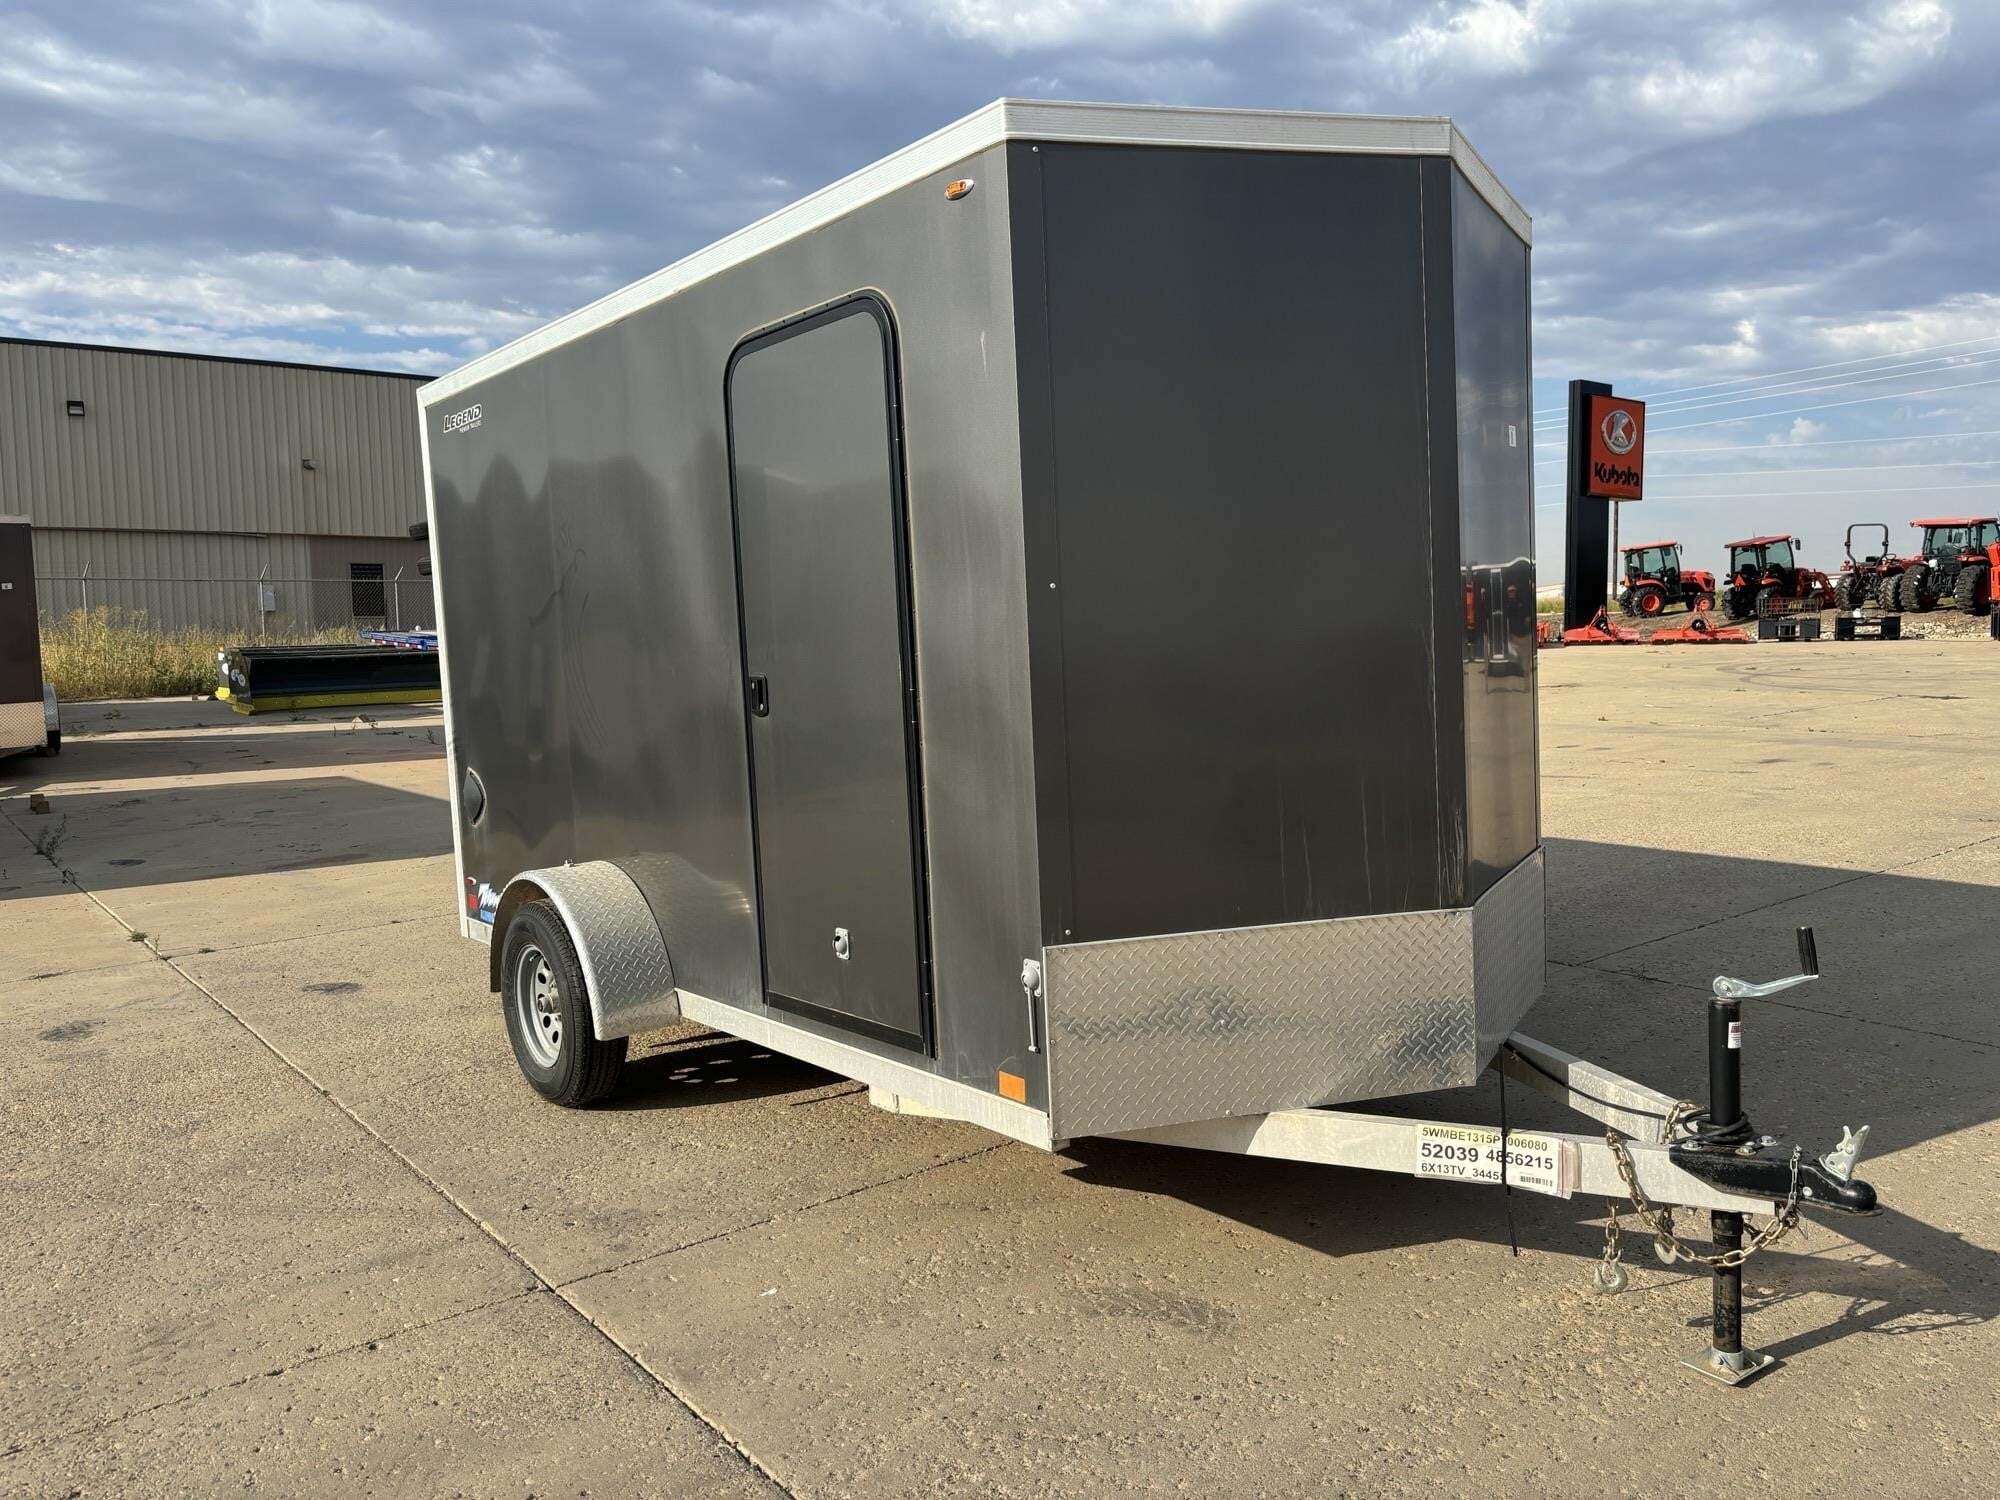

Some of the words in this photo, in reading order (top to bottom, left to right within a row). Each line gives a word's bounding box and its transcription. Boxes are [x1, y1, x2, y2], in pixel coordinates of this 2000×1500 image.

[444, 404, 482, 433] LEGEND
[1594, 462, 1640, 486] Kubota
[1422, 1127, 1548, 1151] 5WMBE1315P006080
[1421, 1142, 1479, 1163] 52039
[1486, 1149, 1553, 1170] 4856215
